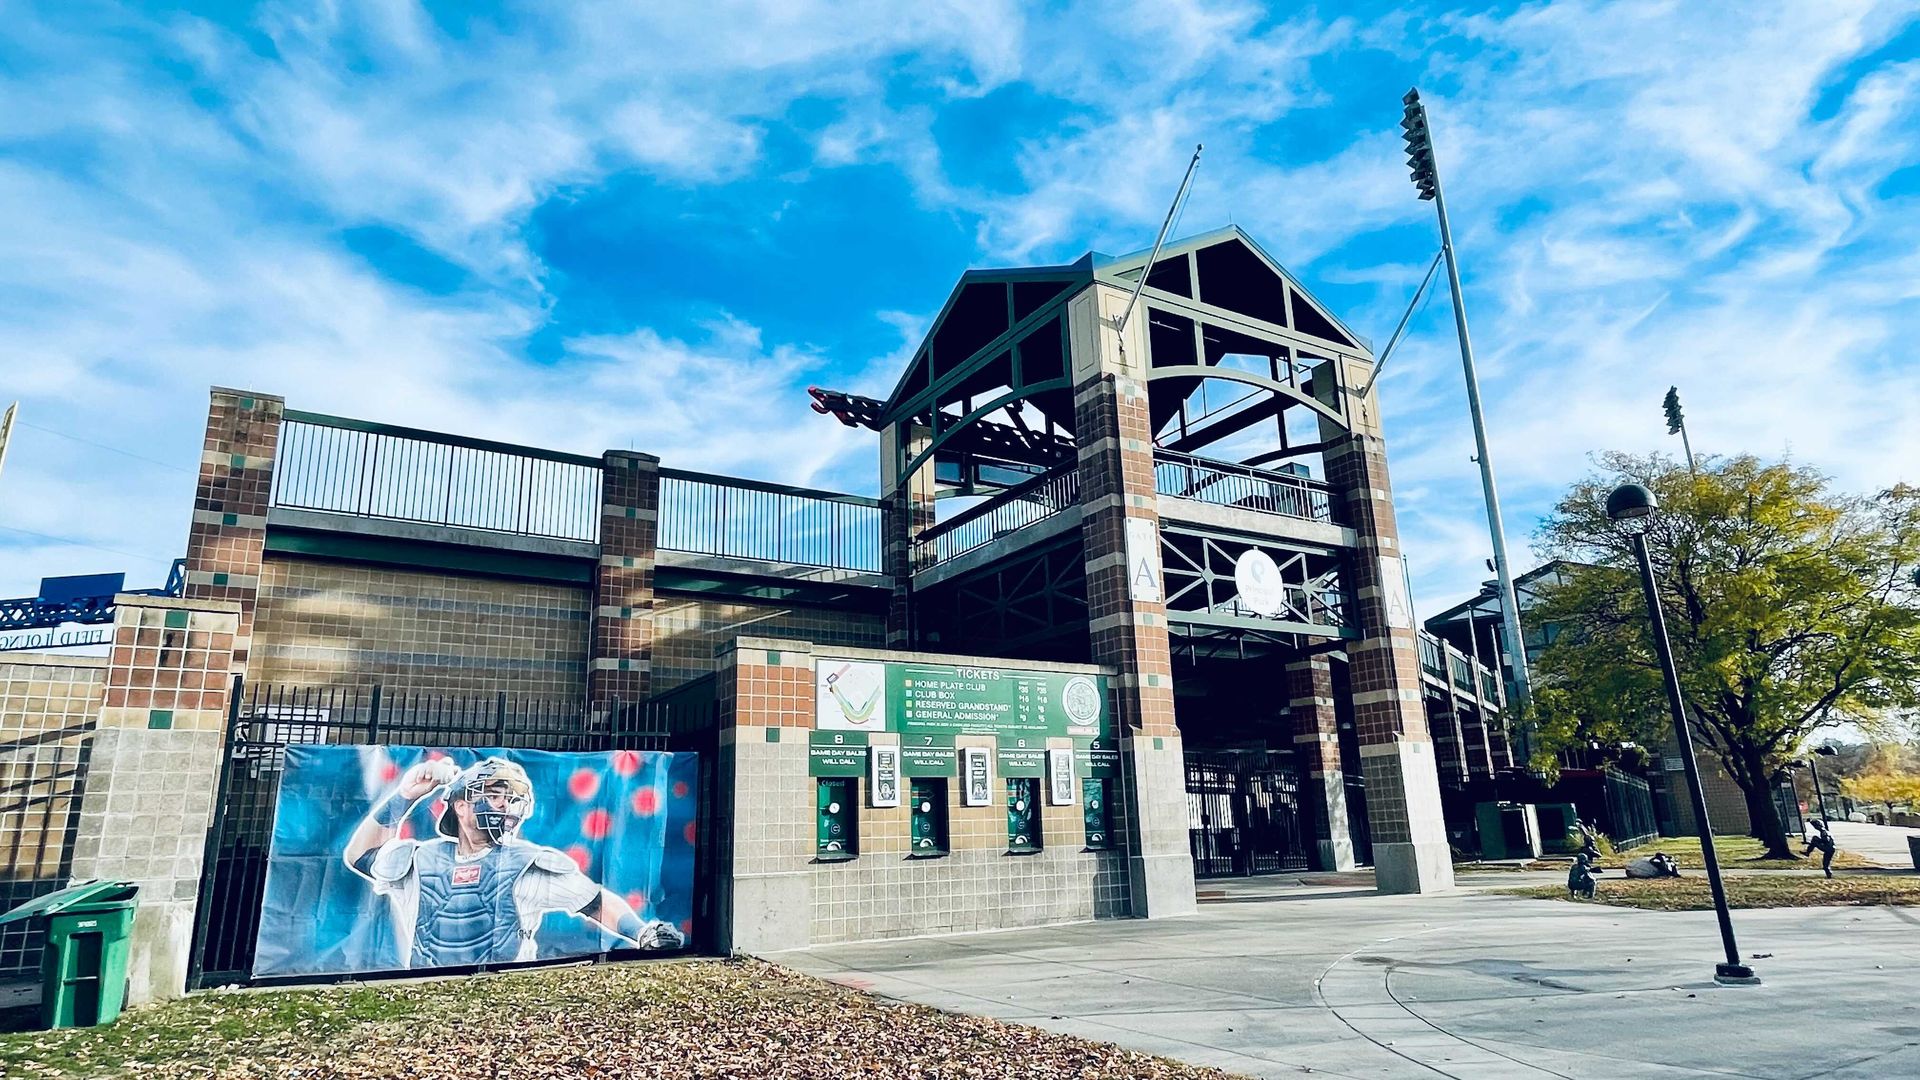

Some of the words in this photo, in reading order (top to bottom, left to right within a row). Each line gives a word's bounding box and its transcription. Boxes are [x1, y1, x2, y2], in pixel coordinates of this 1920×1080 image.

[1134, 557, 1157, 588] A
[1390, 590, 1406, 617] A
[956, 669, 1000, 681] TICKETS
[914, 680, 938, 689] HOME
[940, 681, 964, 690] PLATE
[965, 683, 986, 692] CLUB
[915, 690, 937, 699] CLUB
[938, 691, 955, 700] BOX
[915, 700, 957, 710] RESERVED
[915, 711, 953, 720] GENERAL
[834, 734, 844, 744] 8
[924, 737, 933, 746] 7
[1093, 741, 1101, 749] 5
